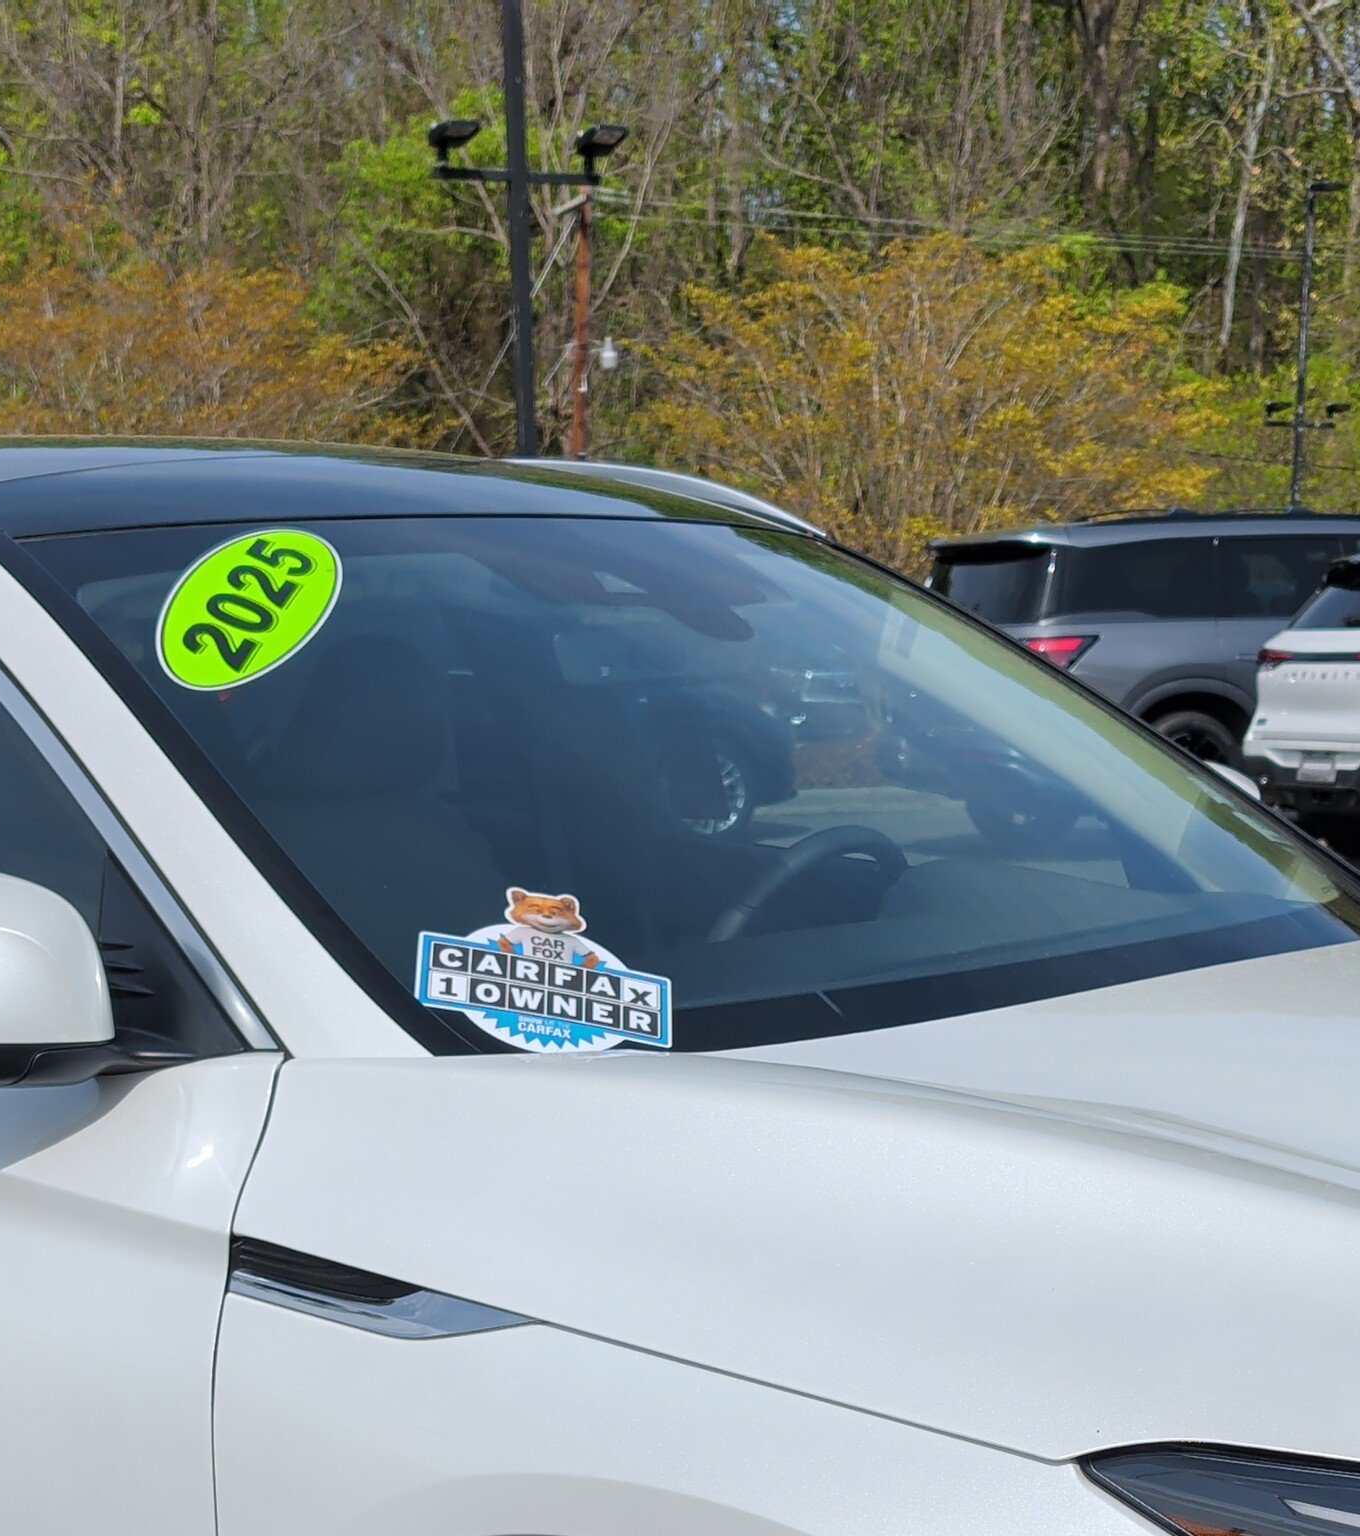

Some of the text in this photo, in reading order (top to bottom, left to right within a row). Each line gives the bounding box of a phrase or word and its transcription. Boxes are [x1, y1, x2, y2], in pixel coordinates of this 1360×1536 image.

[182, 538, 318, 673] 2025
[530, 935, 565, 951] CAR
[532, 947, 565, 961] FOX
[439, 947, 653, 1008] CARFAX
[438, 976, 653, 1033] 1 OWNER
[518, 1021, 572, 1039] CARFAX
